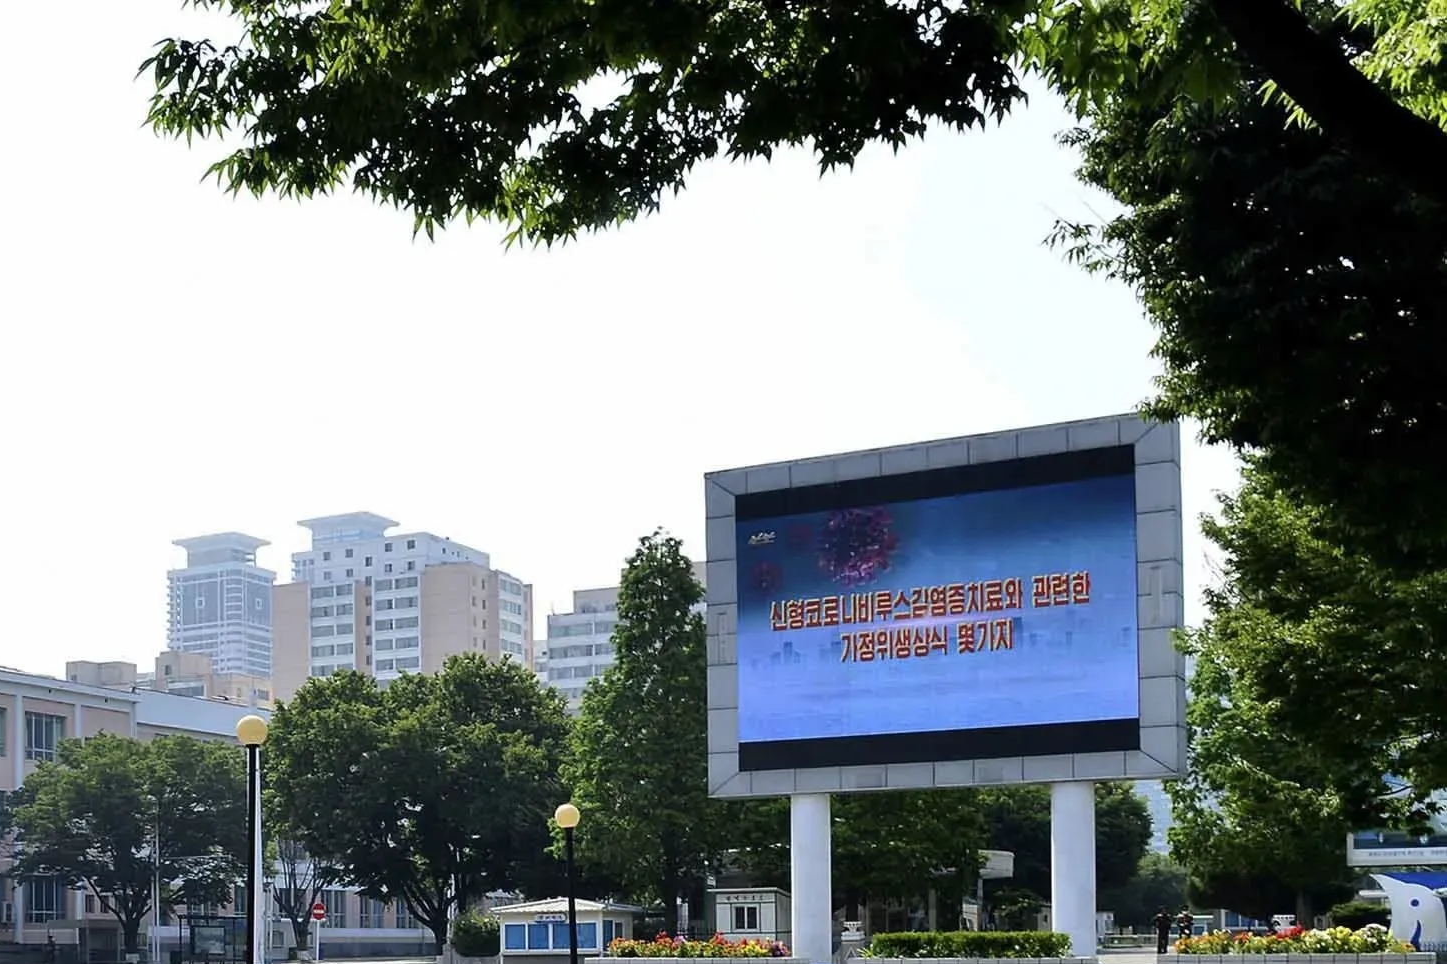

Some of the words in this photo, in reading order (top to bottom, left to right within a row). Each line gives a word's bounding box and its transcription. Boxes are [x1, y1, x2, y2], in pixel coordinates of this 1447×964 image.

[1031, 570, 1091, 608] 관련한
[840, 625, 948, 663] 가정위생상식
[958, 618, 1014, 654] 몇가지
